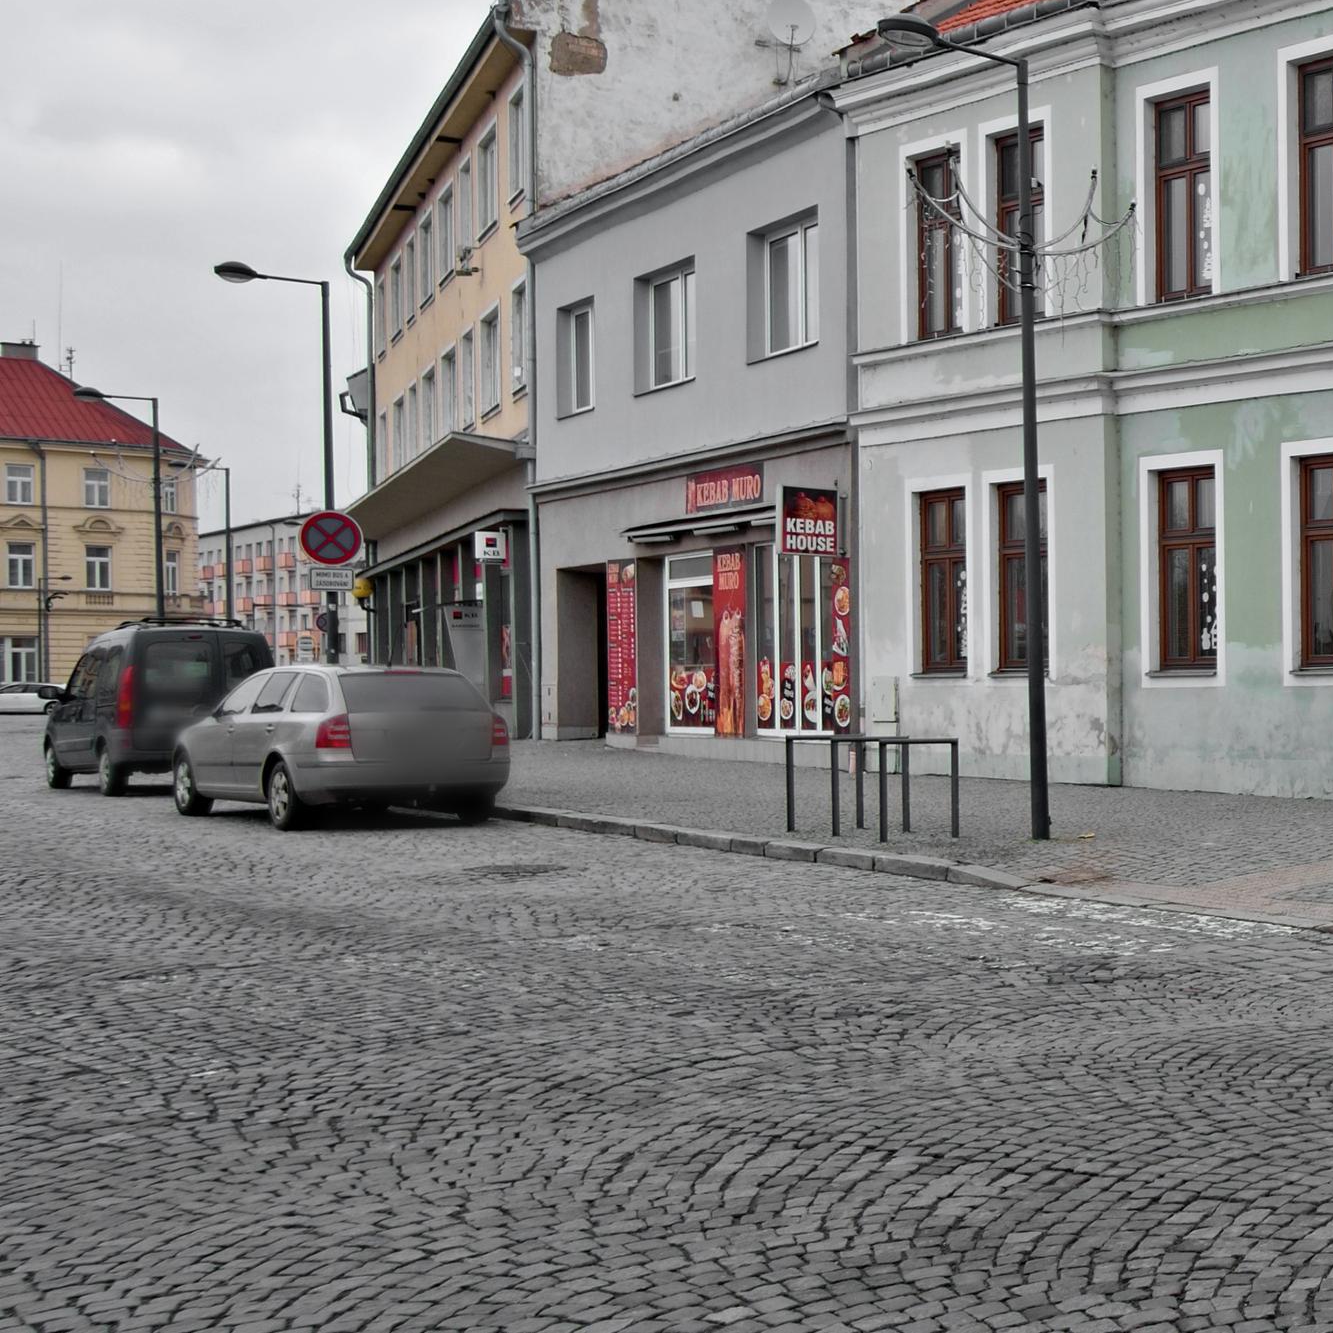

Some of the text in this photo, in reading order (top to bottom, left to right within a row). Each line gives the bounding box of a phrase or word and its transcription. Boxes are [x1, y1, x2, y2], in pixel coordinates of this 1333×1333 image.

[696, 474, 762, 507] KEBAB MURO
[786, 517, 835, 535] KEBAB
[786, 535, 835, 552] HOUSE
[717, 552, 741, 573] KEBAB
[718, 572, 739, 590] MURO
